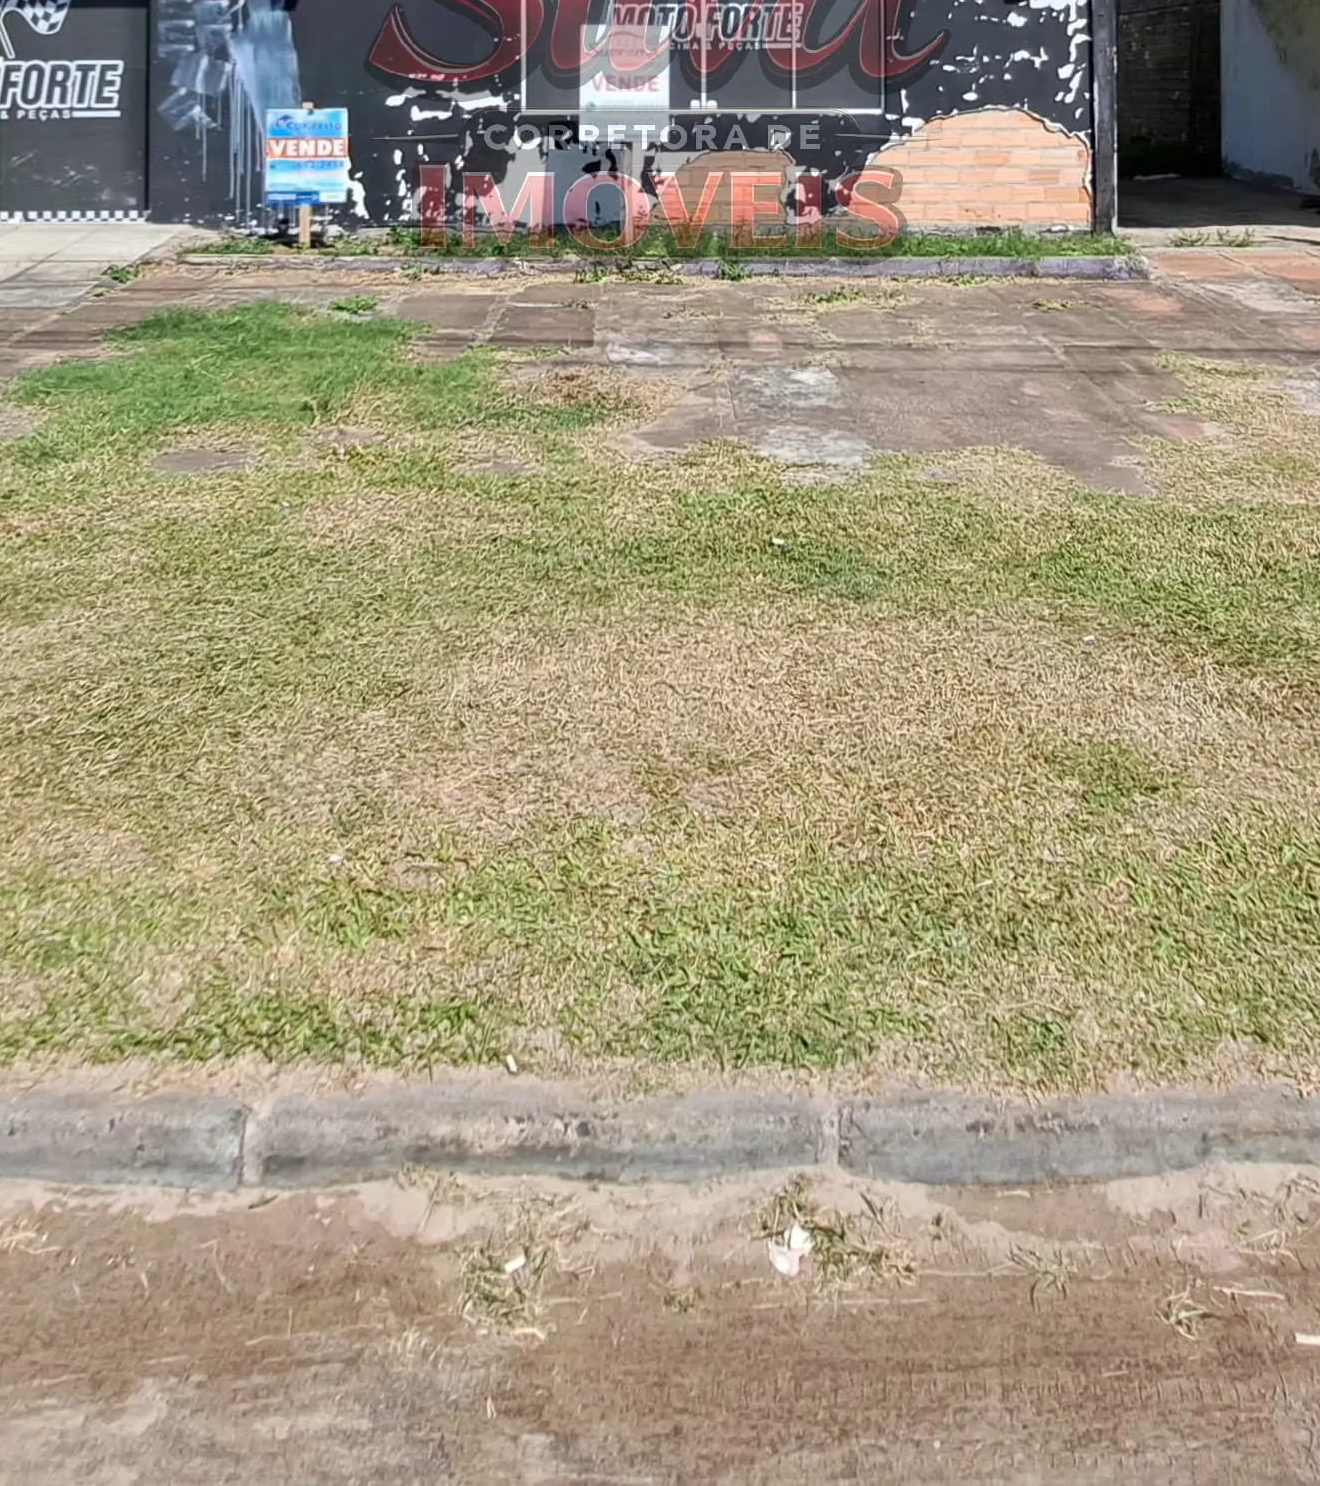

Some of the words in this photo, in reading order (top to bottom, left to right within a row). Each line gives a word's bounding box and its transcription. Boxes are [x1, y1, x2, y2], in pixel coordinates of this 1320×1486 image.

[613, 3, 698, 40] MOTO
[703, 3, 805, 42] FORTE
[592, 75, 660, 93] VENDE
[17, 110, 72, 121] PEÇAS
[267, 139, 344, 156] VENDE
